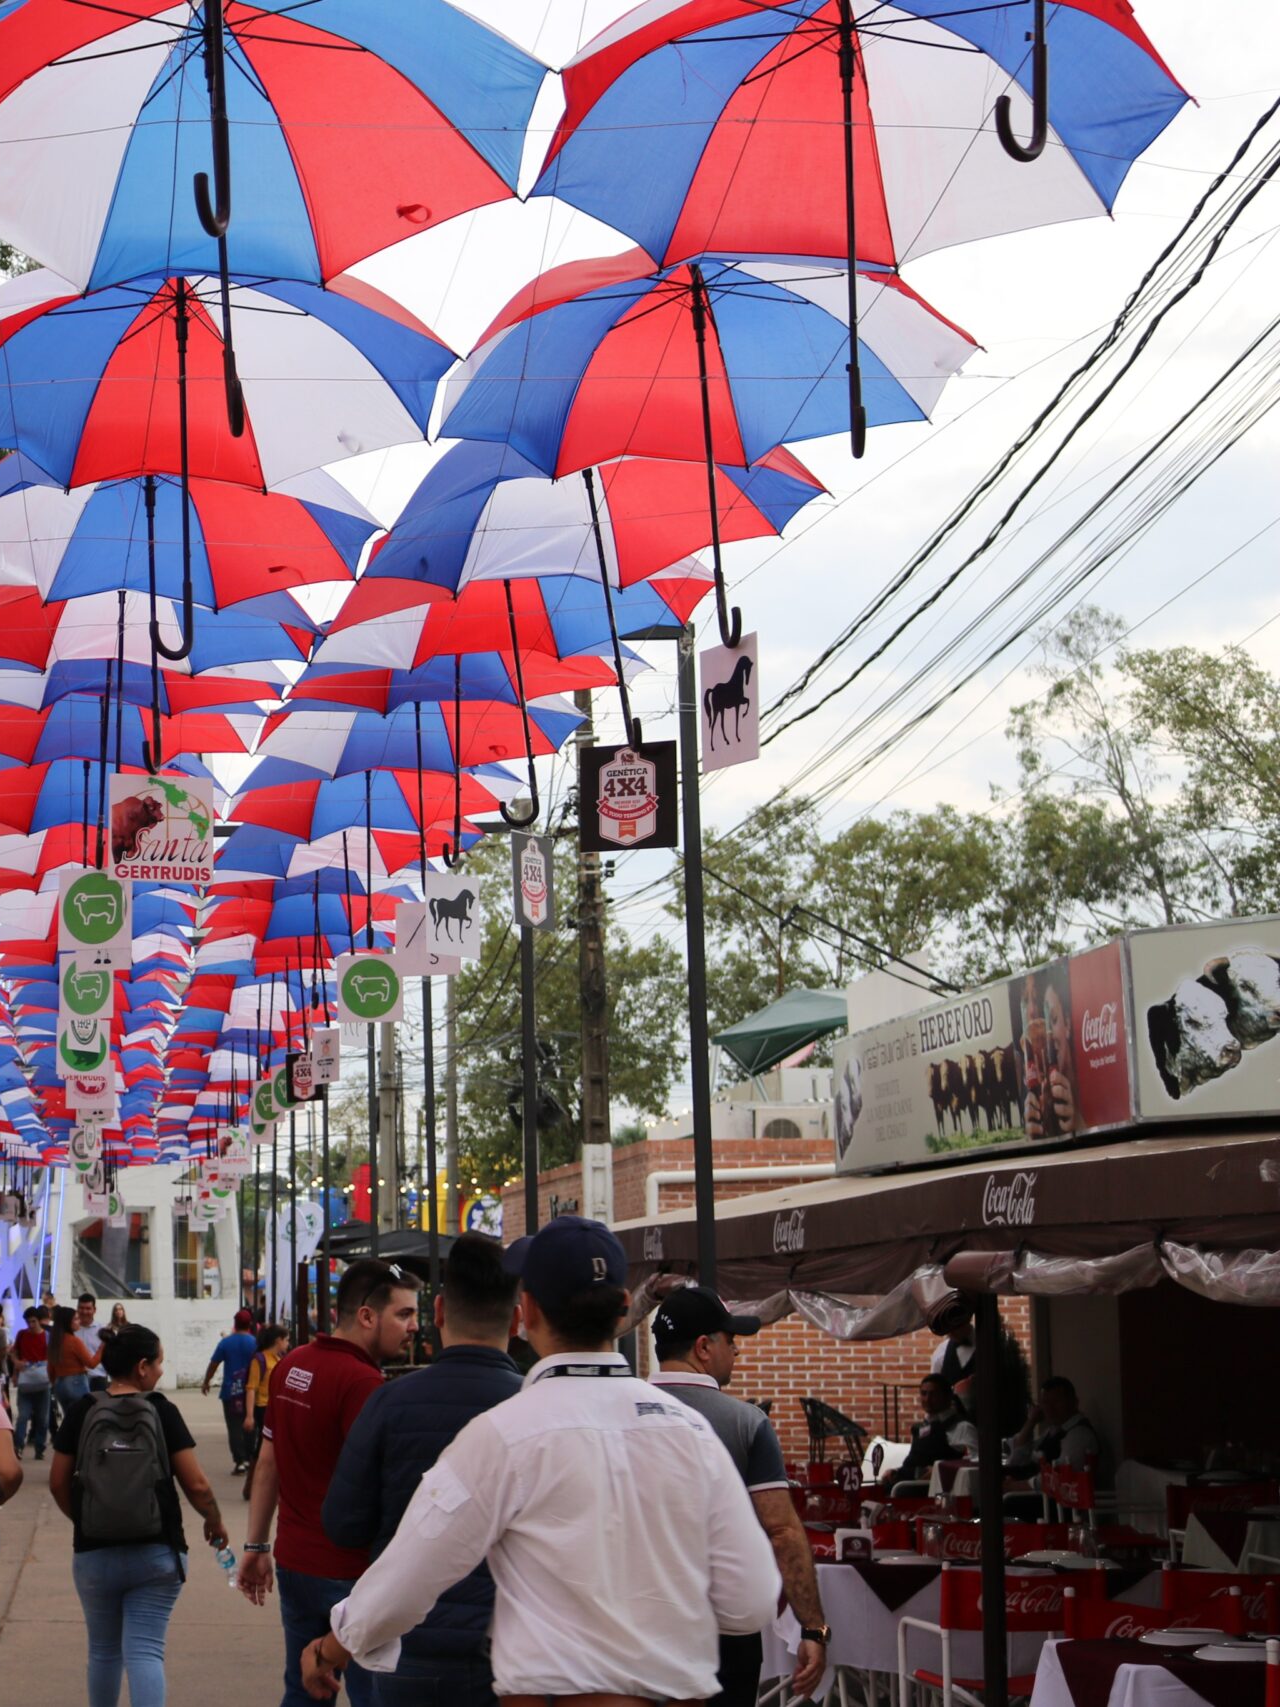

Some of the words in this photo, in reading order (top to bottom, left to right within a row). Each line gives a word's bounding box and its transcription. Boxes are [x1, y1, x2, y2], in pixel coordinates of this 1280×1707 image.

[604, 776, 647, 797] 4X4
[122, 828, 208, 863] Santa
[115, 864, 210, 881] GERTRUDIS
[524, 864, 542, 883] 4X4
[919, 998, 994, 1053] HEREFORD
[842, 1466, 860, 1491] 25
